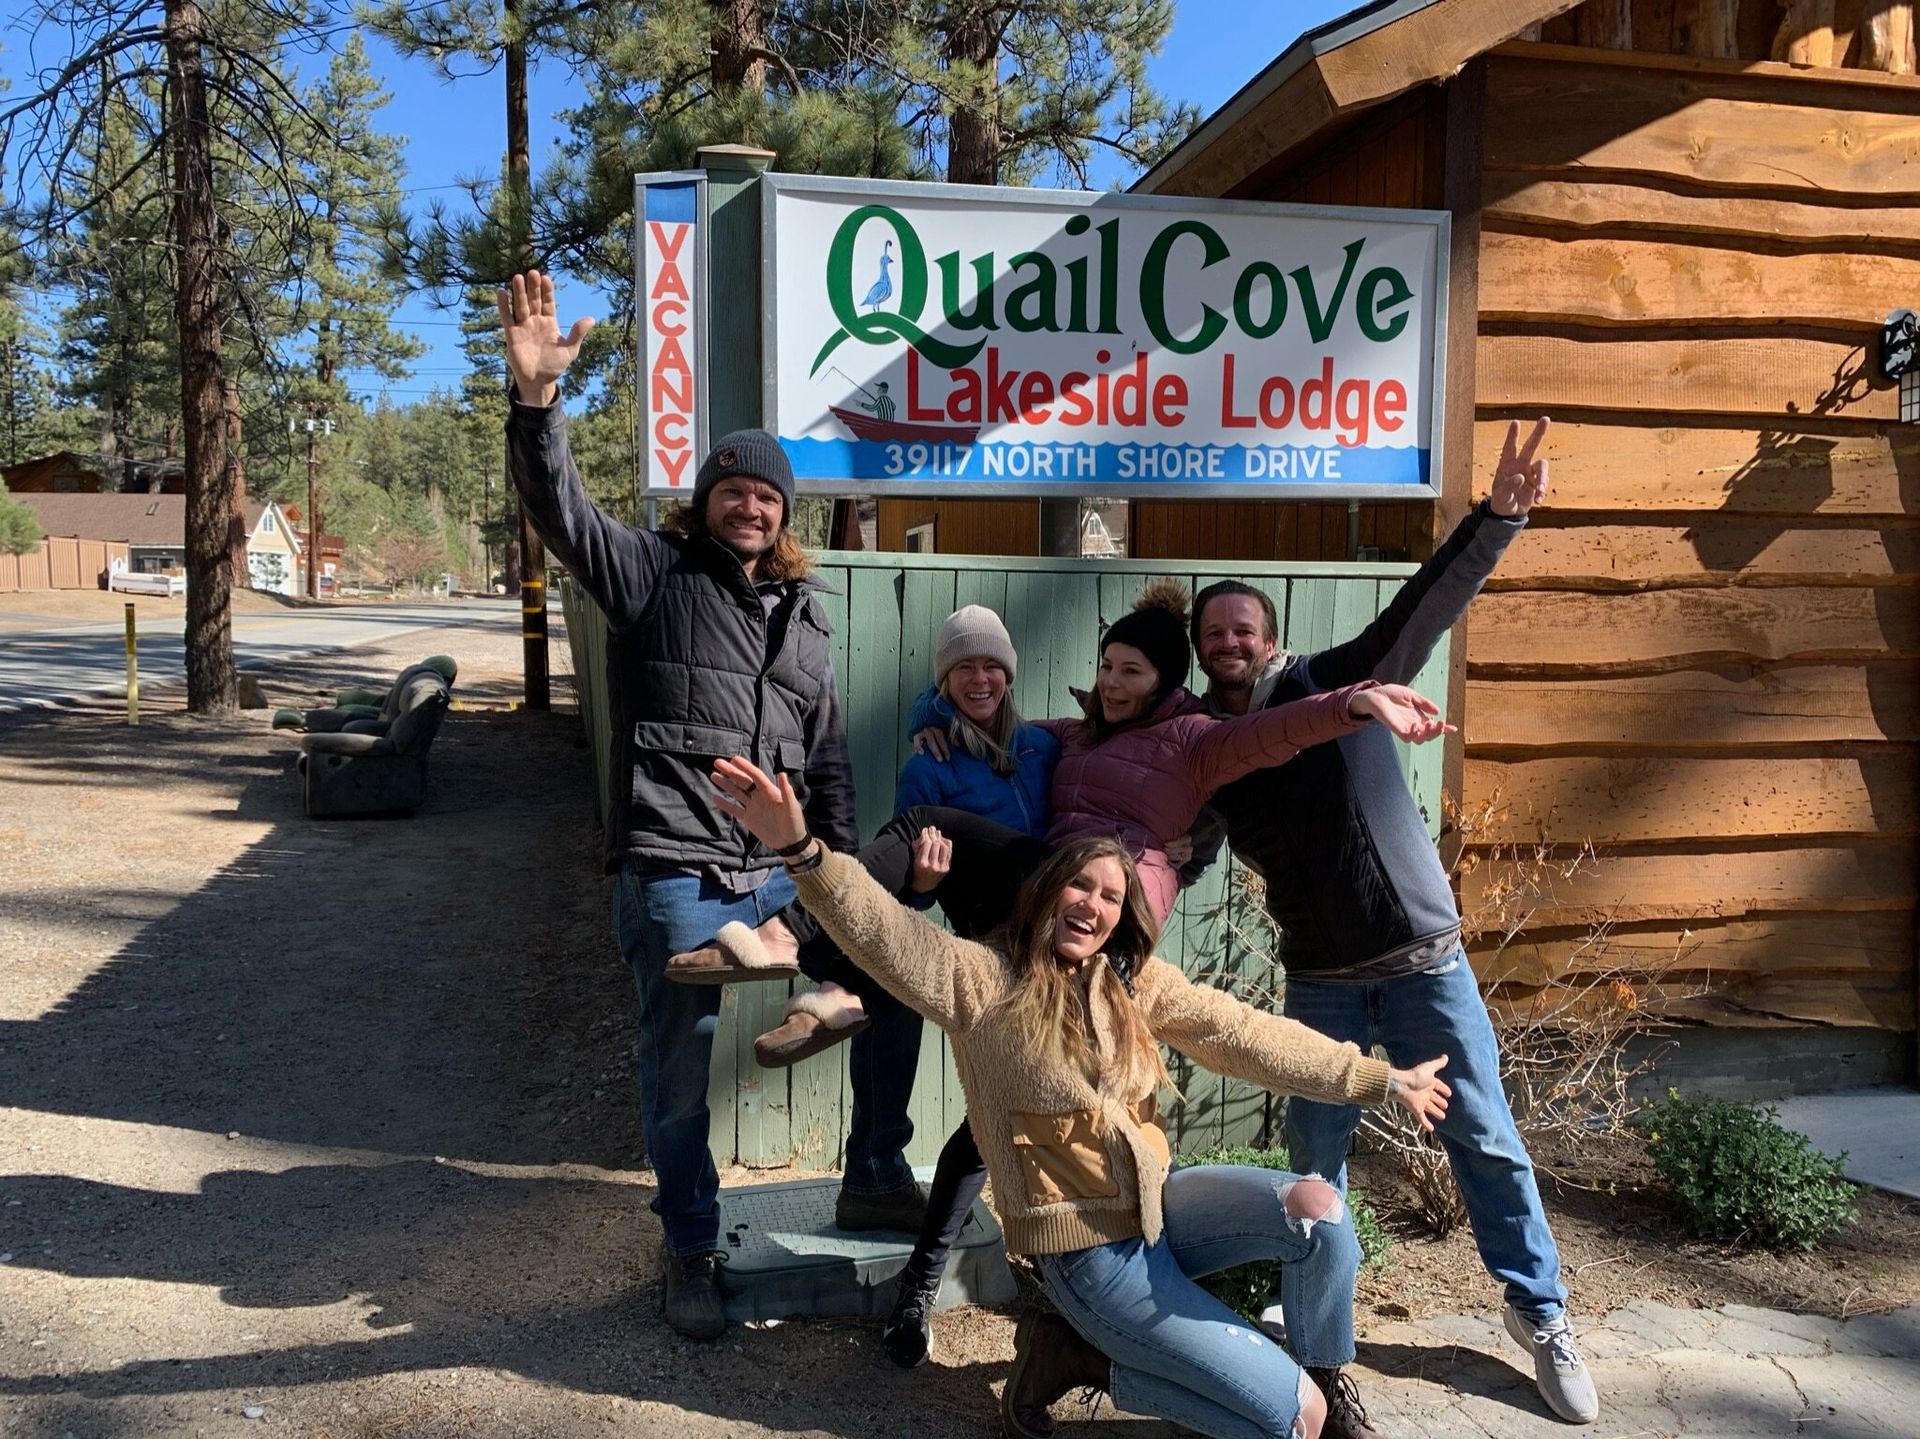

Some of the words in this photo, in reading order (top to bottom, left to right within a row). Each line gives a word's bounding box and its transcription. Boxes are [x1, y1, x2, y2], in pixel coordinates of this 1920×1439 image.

[650, 221, 693, 487] VACANCY
[809, 204, 1121, 380] Quail
[1138, 219, 1415, 355] Cove
[883, 445, 973, 477] 39117
[982, 446, 1097, 478] NORTH
[1116, 448, 1226, 479] SHORE
[1245, 449, 1342, 480] DRIVE
[906, 347, 1189, 427] Lakeside
[1221, 353, 1408, 447] Lodge
